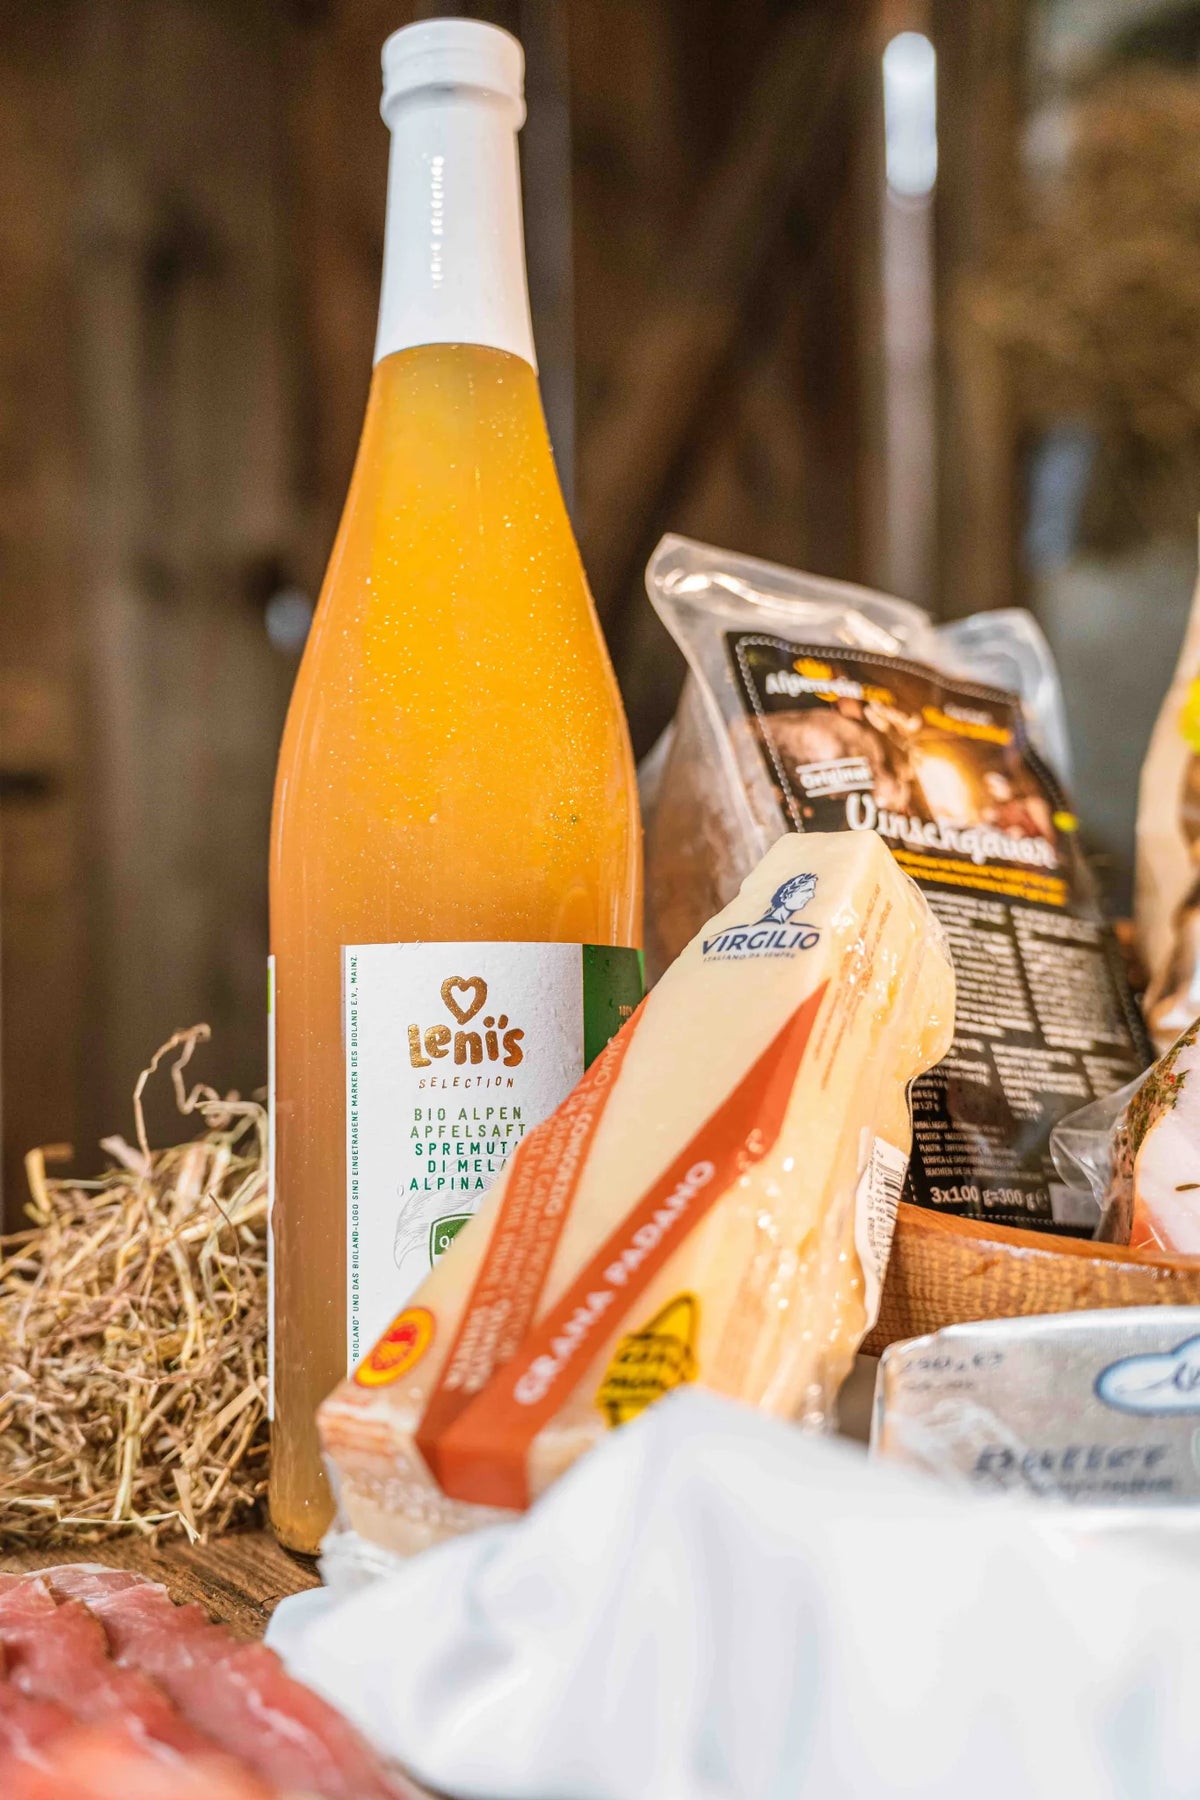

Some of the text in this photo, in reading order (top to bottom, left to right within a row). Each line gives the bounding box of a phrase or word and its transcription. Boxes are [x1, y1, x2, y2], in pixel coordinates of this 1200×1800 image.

[702, 930, 820, 955] VIRGILIO
[350, 1009, 358, 1047] BIOLAND
[351, 1071, 359, 1107] MARKEN
[418, 1076, 515, 1089] SELECTION
[414, 1107, 521, 1121] BIO ALPEN
[410, 1124, 525, 1138] APFELSAFT
[351, 1111, 359, 1176] EINGETRAGENE
[427, 1159, 446, 1173] DI
[351, 1179, 359, 1200] SIND
[410, 1176, 485, 1191] ALPINA
[929, 1185, 979, 1203] 3x100
[351, 1203, 360, 1269] BIOLAND-LOGO
[352, 1272, 360, 1290] DAS
[513, 1290, 615, 1405] GRANA
[603, 1160, 716, 1286] PADANO
[352, 1294, 360, 1312] UND
